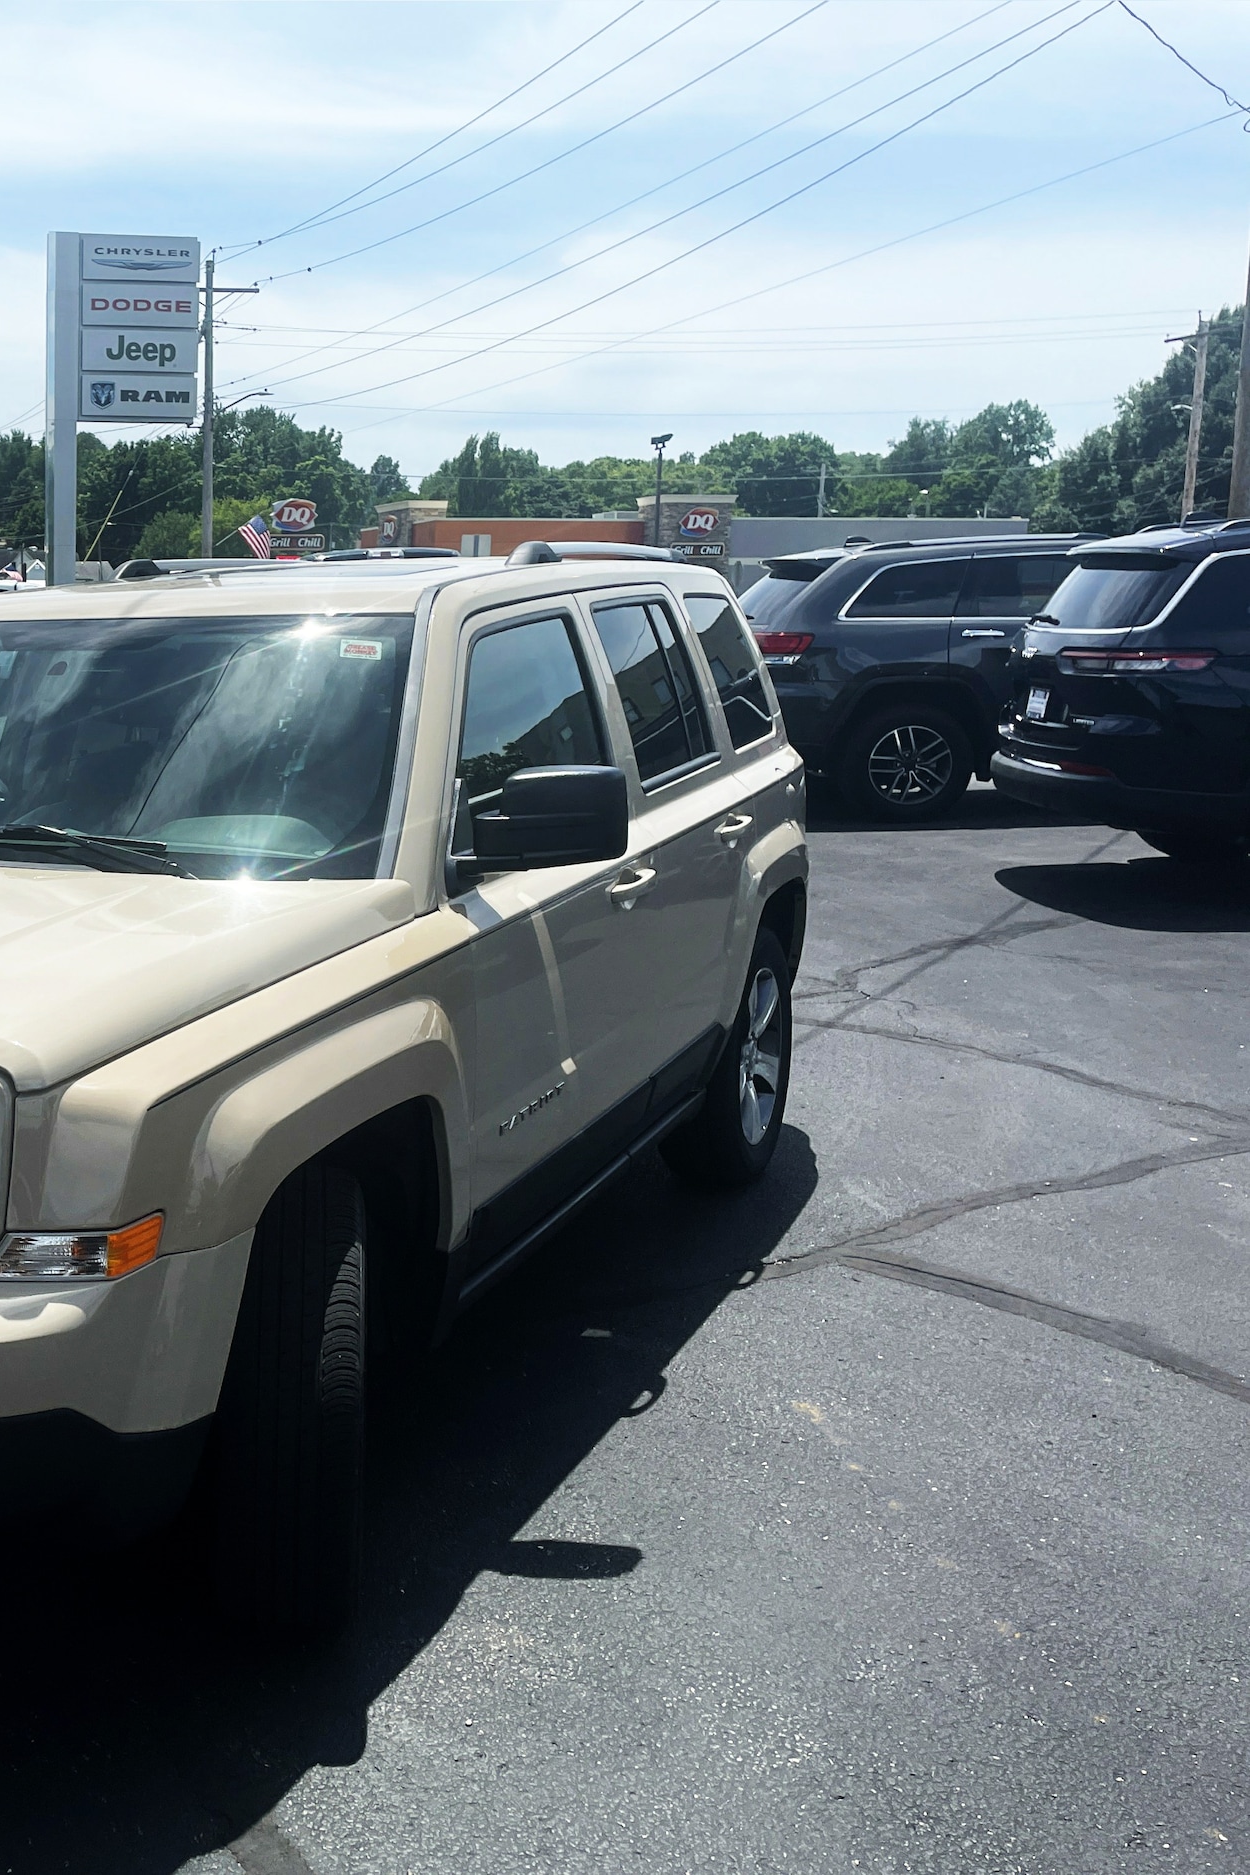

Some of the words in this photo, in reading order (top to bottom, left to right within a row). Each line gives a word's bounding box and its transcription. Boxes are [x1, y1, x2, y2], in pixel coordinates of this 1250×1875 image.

[94, 247, 191, 258] CHRYSLER
[91, 298, 192, 313] DODGE
[106, 335, 177, 367] Jeep
[120, 389, 190, 403] RAM
[281, 507, 310, 525] DQ
[686, 514, 714, 530] DQ
[383, 521, 394, 537] DQ
[270, 537, 291, 547] Grill
[298, 537, 321, 547] Chill
[700, 546, 721, 554] Chill
